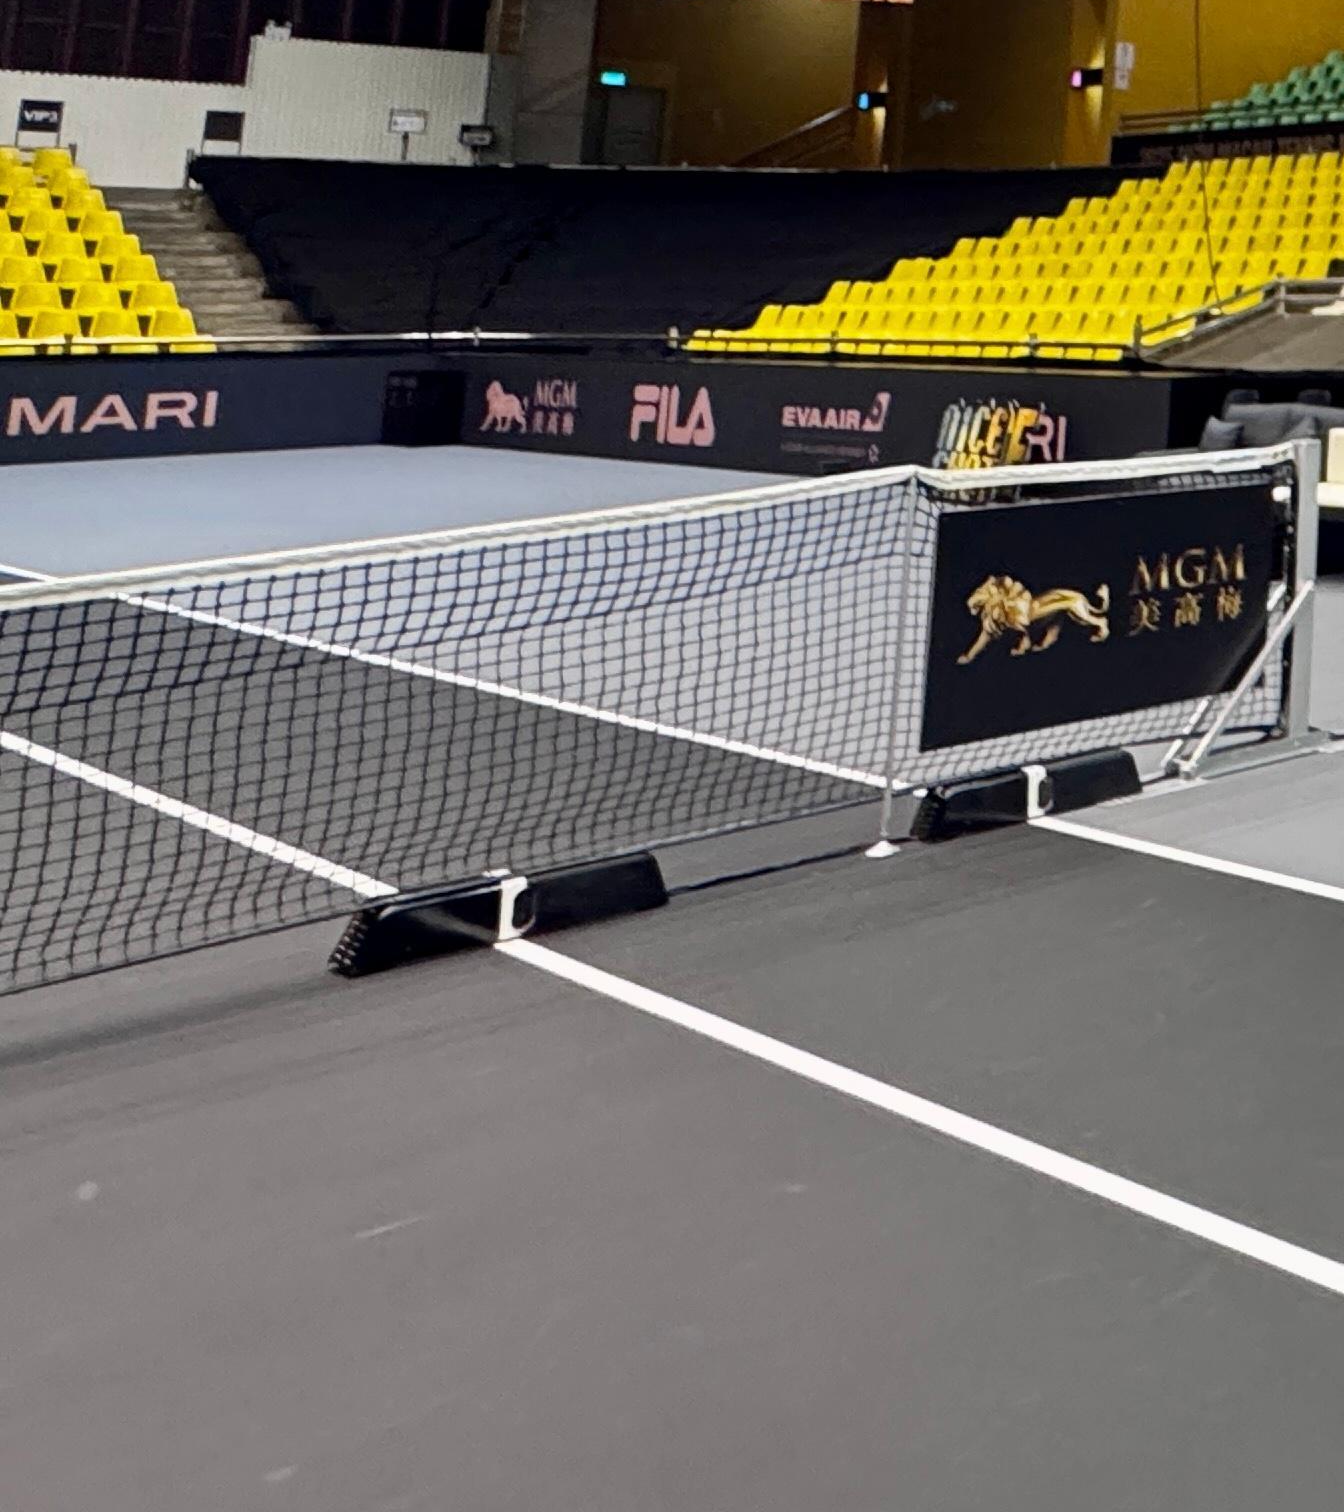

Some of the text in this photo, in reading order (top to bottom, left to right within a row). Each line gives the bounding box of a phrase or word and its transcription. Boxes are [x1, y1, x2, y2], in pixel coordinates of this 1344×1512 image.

[6, 390, 219, 437] MARI
[534, 379, 577, 409] MGM
[629, 383, 715, 447] FILA
[1128, 543, 1248, 596] MGM
